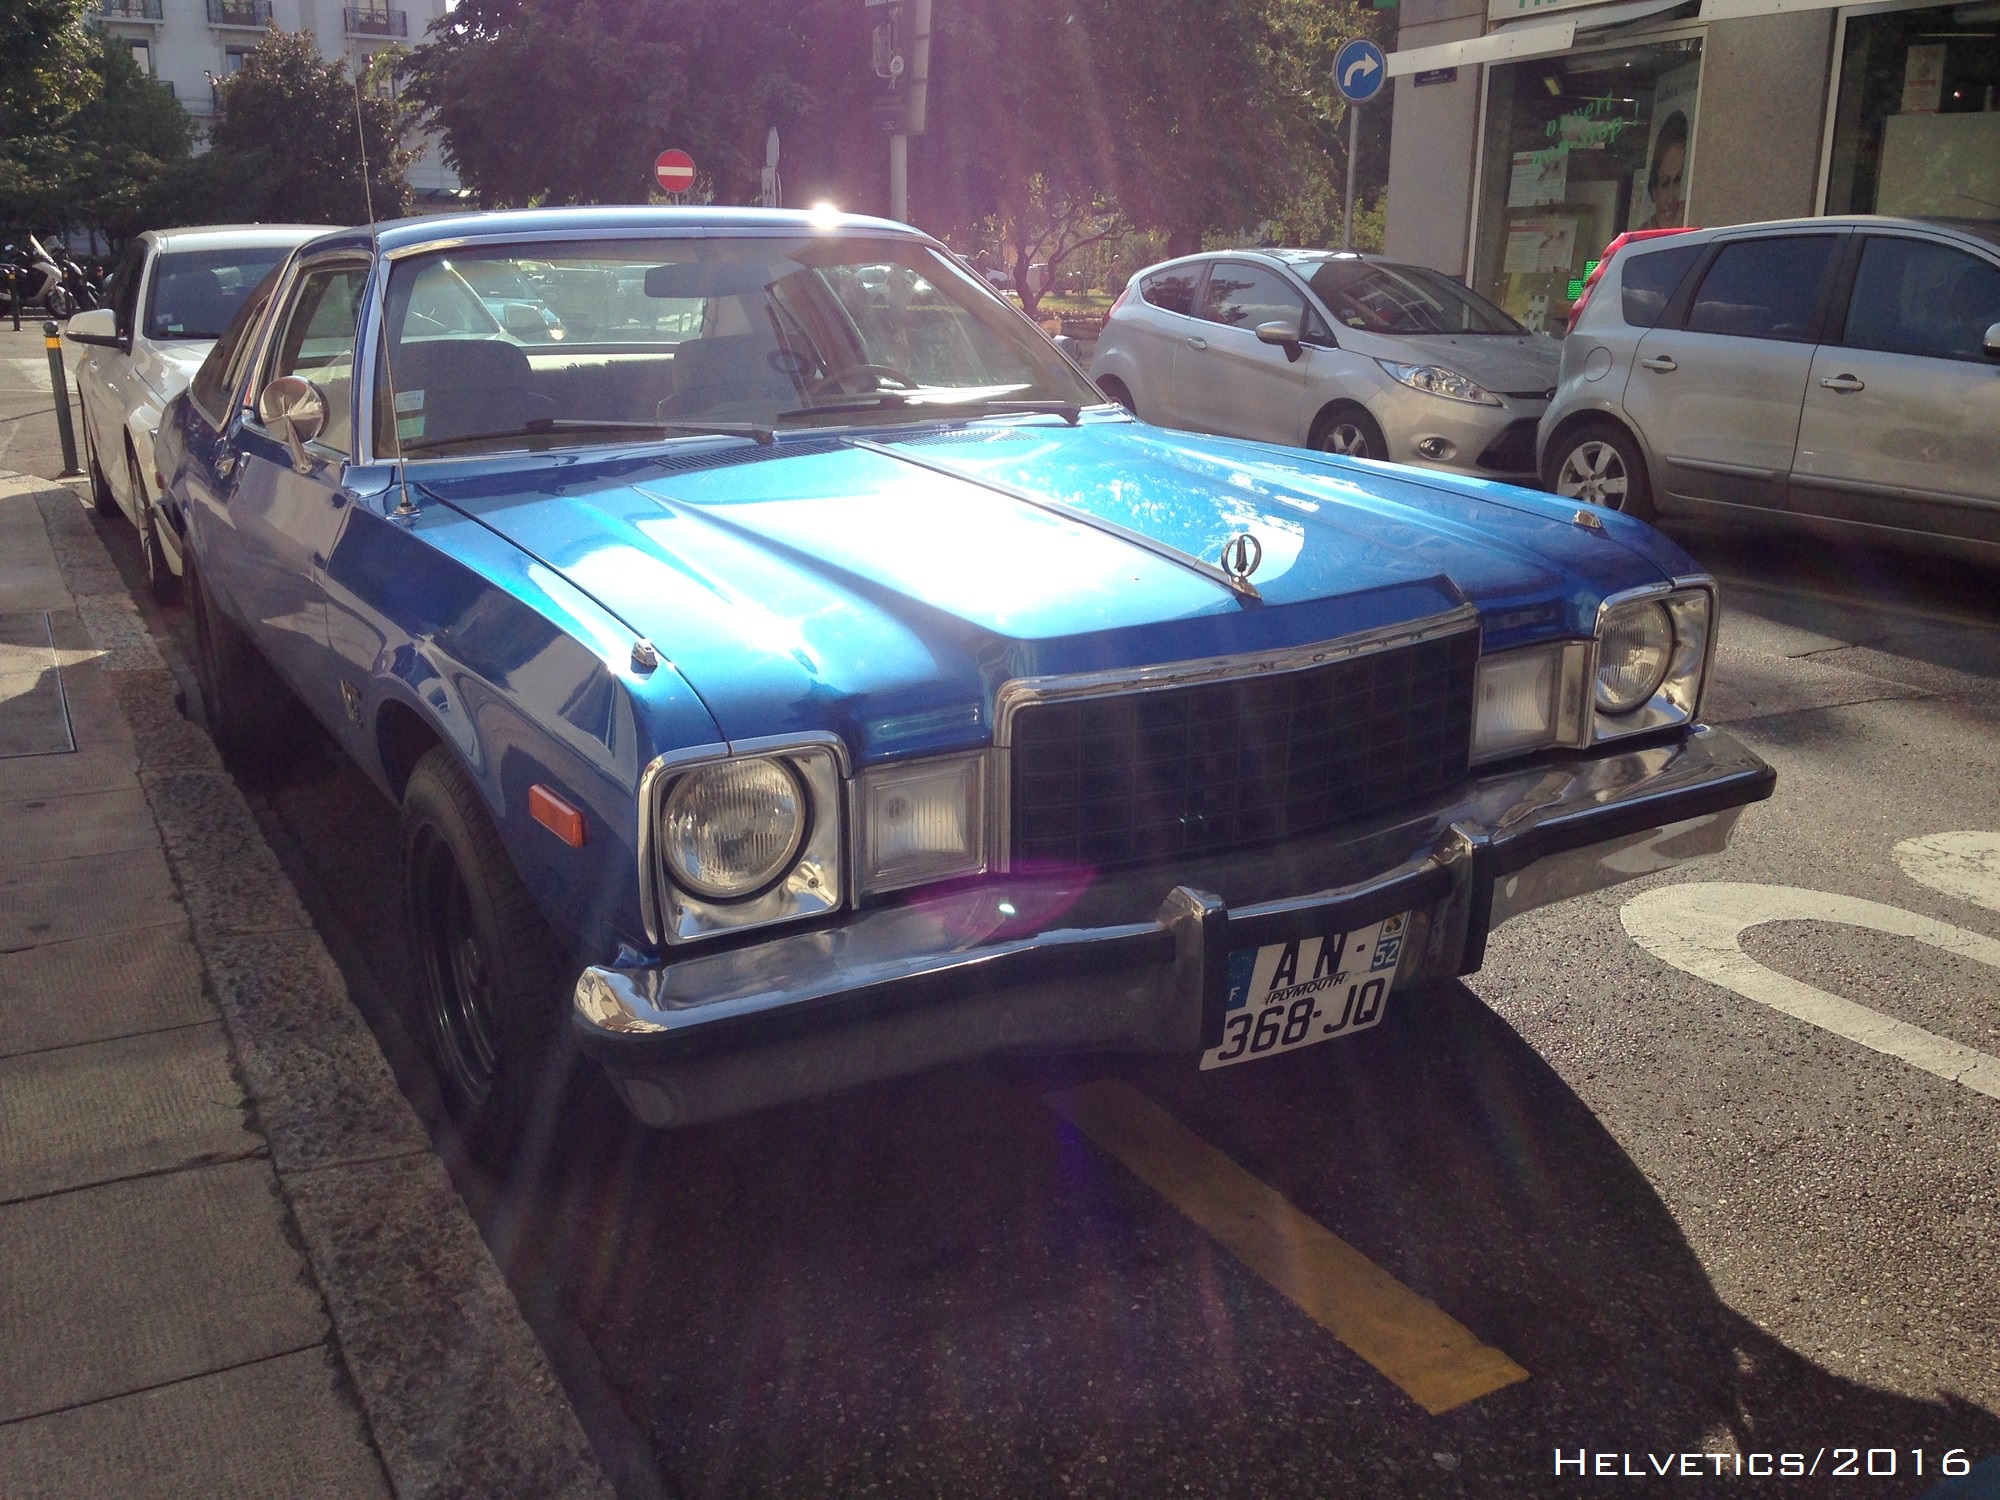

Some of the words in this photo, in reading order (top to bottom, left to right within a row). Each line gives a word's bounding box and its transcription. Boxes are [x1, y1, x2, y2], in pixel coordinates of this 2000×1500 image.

[1373, 940, 1400, 967] 52
[1229, 986, 1240, 1002] F
[1270, 974, 1346, 1003] PLYMOUTH
[1218, 977, 1386, 1060] 368-JQ
